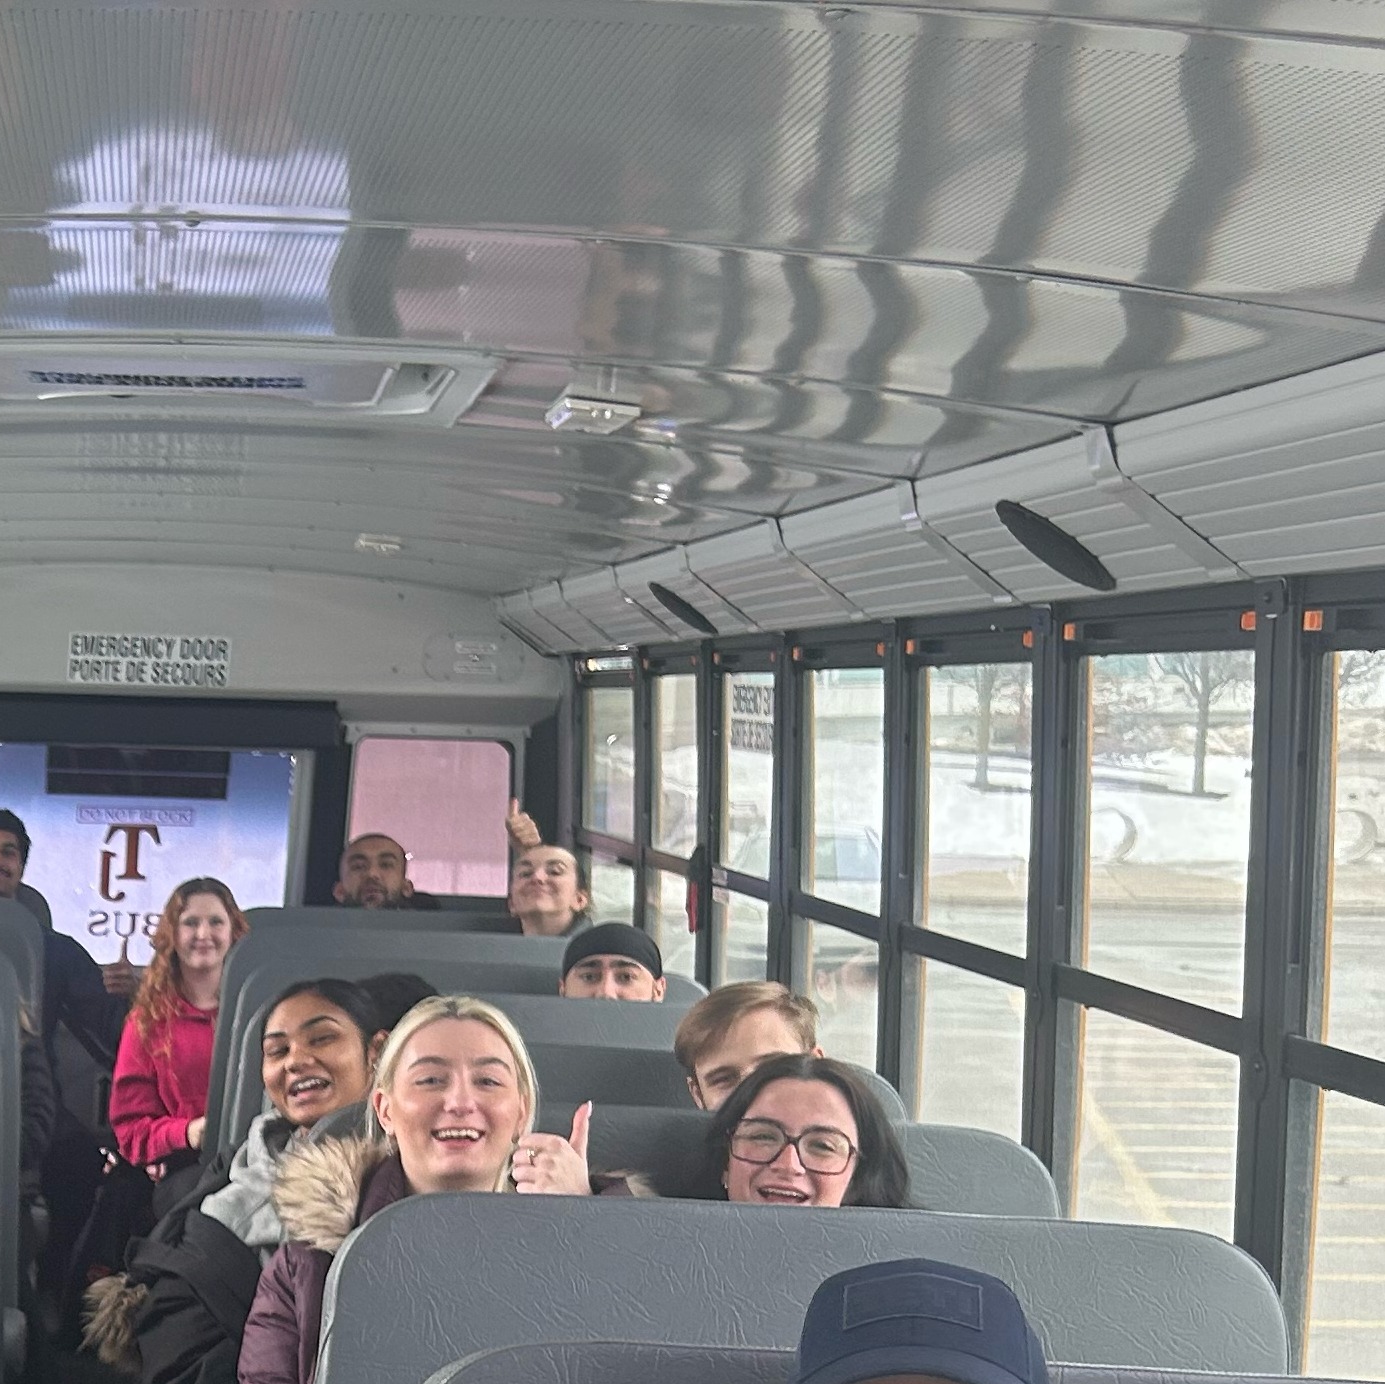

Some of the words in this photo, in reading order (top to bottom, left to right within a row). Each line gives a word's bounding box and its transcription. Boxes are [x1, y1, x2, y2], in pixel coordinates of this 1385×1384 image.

[71, 634, 176, 659] EMERGENCY
[180, 637, 229, 661] DOOR
[69, 658, 121, 682] PORTE
[125, 660, 148, 683] DE
[151, 661, 228, 687] SECOURS
